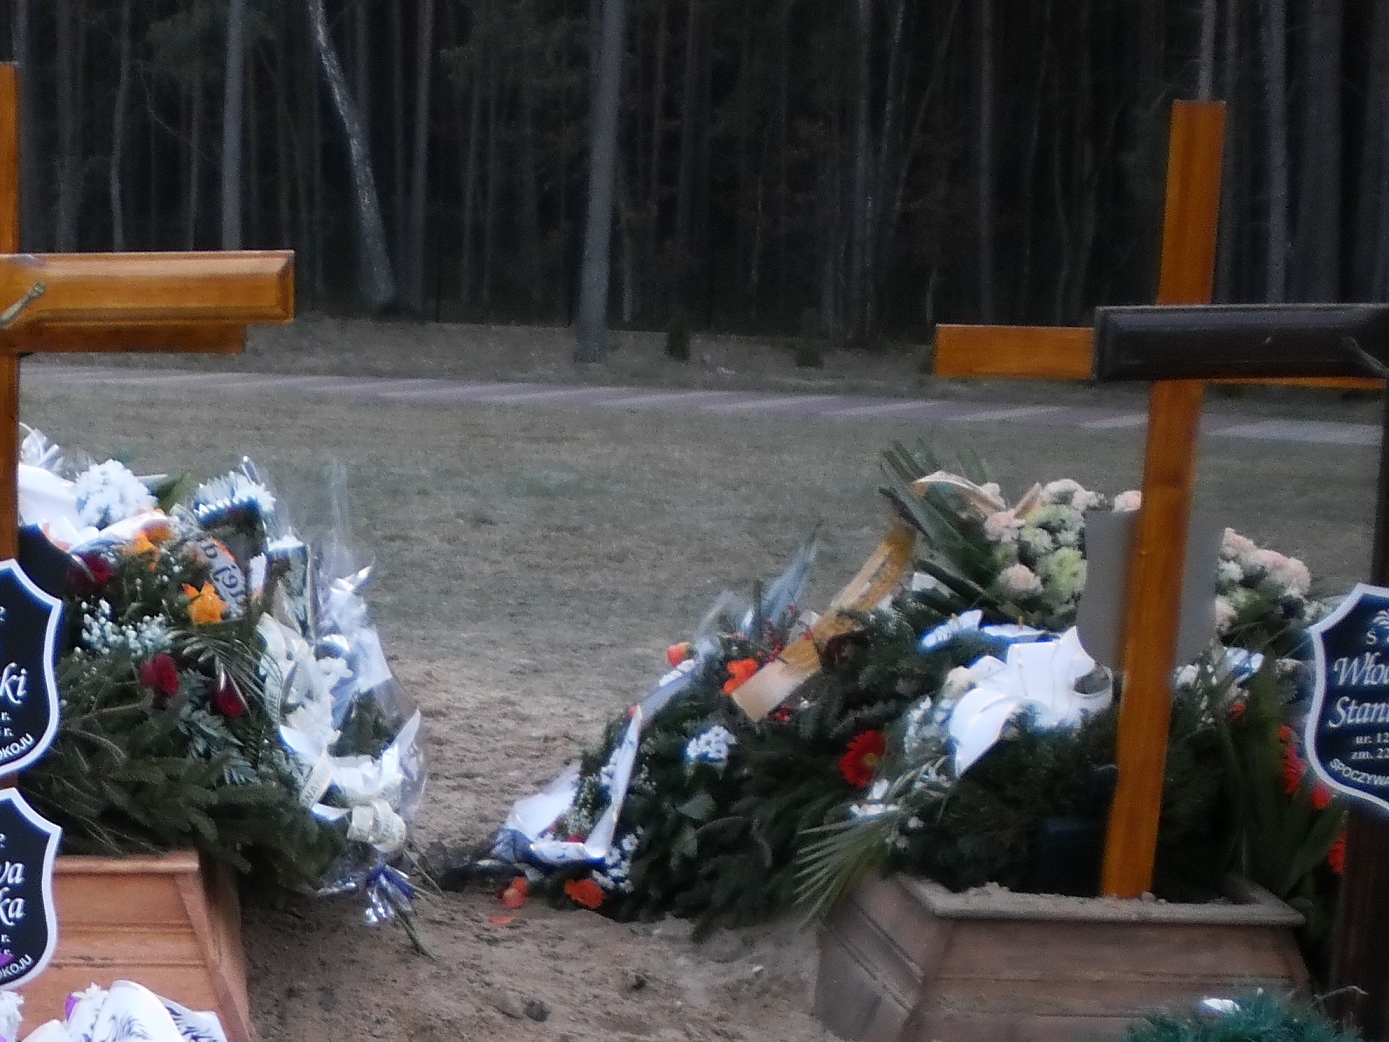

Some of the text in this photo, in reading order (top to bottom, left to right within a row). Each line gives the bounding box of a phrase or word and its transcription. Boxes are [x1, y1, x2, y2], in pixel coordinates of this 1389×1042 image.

[1, 711, 12, 722] r.
[1328, 696, 1389, 728] Stan
[4, 727, 14, 737] r.
